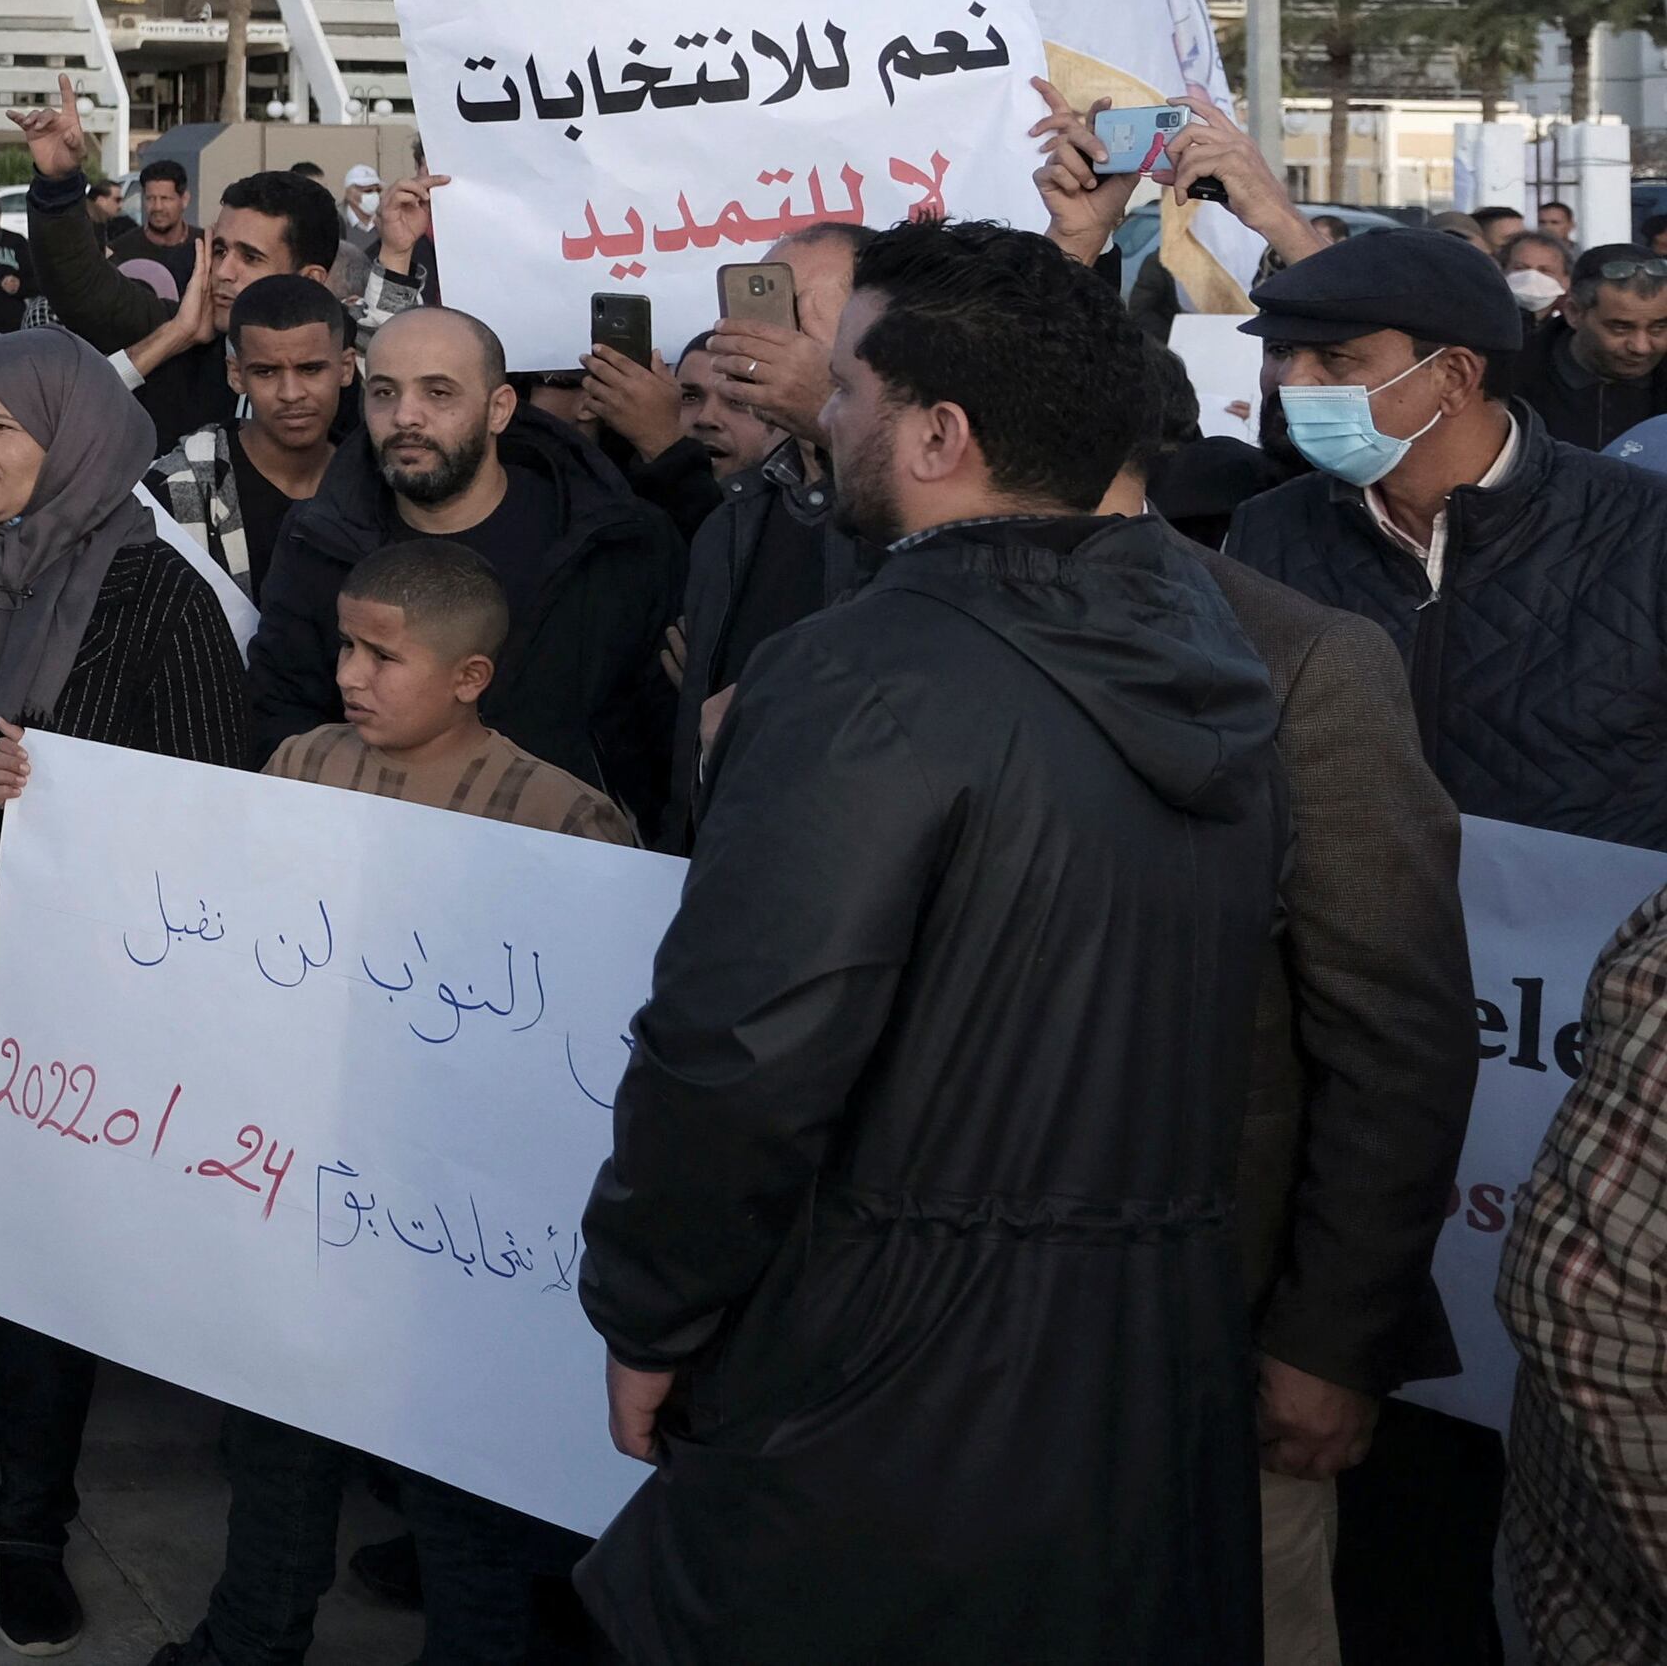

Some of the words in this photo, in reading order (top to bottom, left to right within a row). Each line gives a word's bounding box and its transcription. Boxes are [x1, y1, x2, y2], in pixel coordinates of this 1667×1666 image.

[455, 18, 851, 142] للانتخابات
[877, 0, 1010, 108] نعم
[560, 160, 865, 281] للتمديد
[888, 149, 951, 225] لا
[254, 899, 334, 988] لن
[361, 930, 545, 1044] النواب
